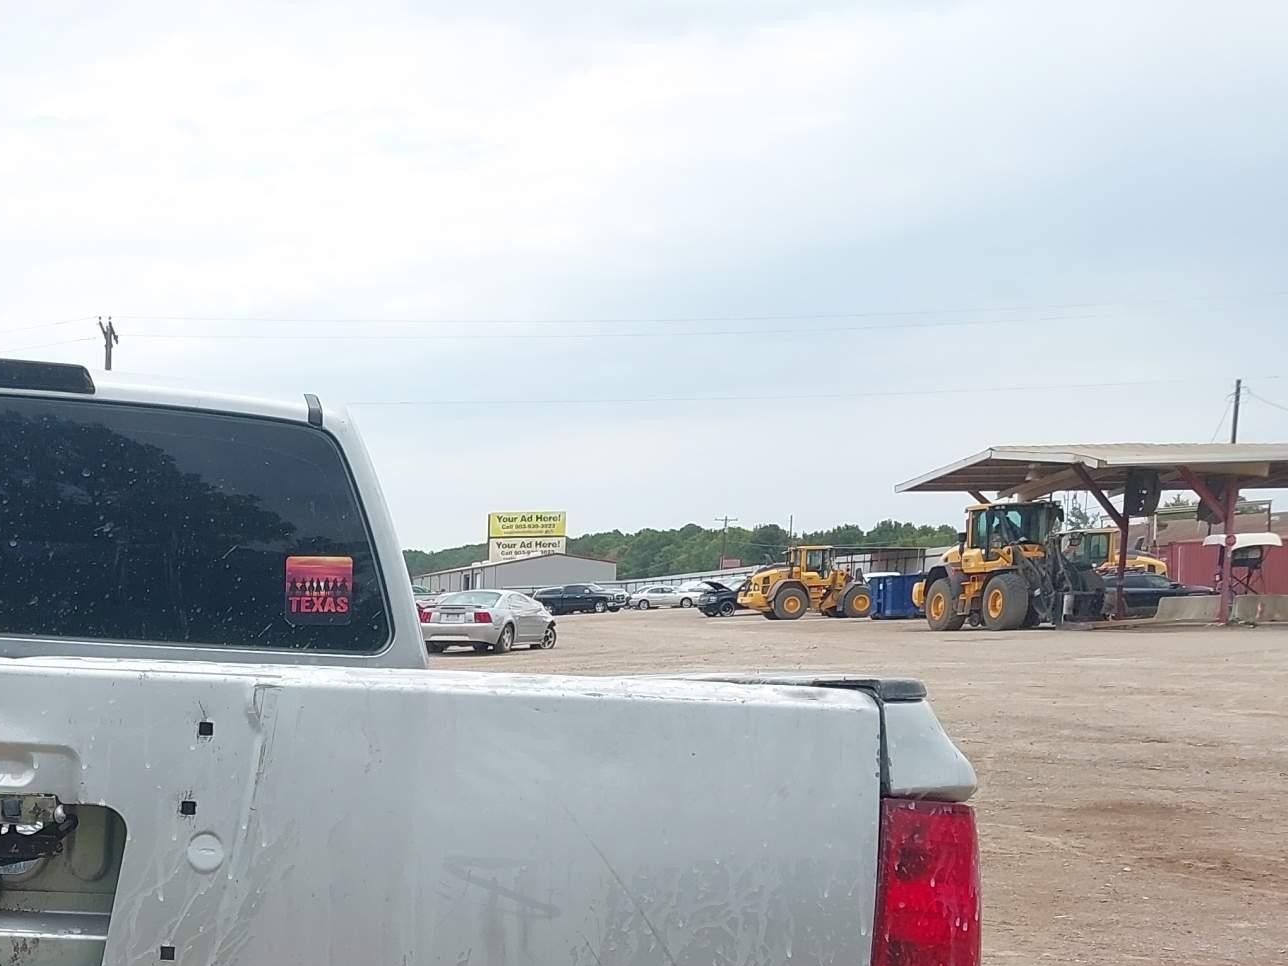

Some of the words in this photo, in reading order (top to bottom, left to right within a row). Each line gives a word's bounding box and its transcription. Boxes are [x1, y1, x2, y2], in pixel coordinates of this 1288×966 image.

[497, 515, 518, 523] Your
[536, 514, 561, 522] Here!
[496, 541, 517, 549] Your
[519, 541, 532, 549] Ad
[535, 540, 561, 548] Here!
[289, 596, 349, 613] TEXAS
